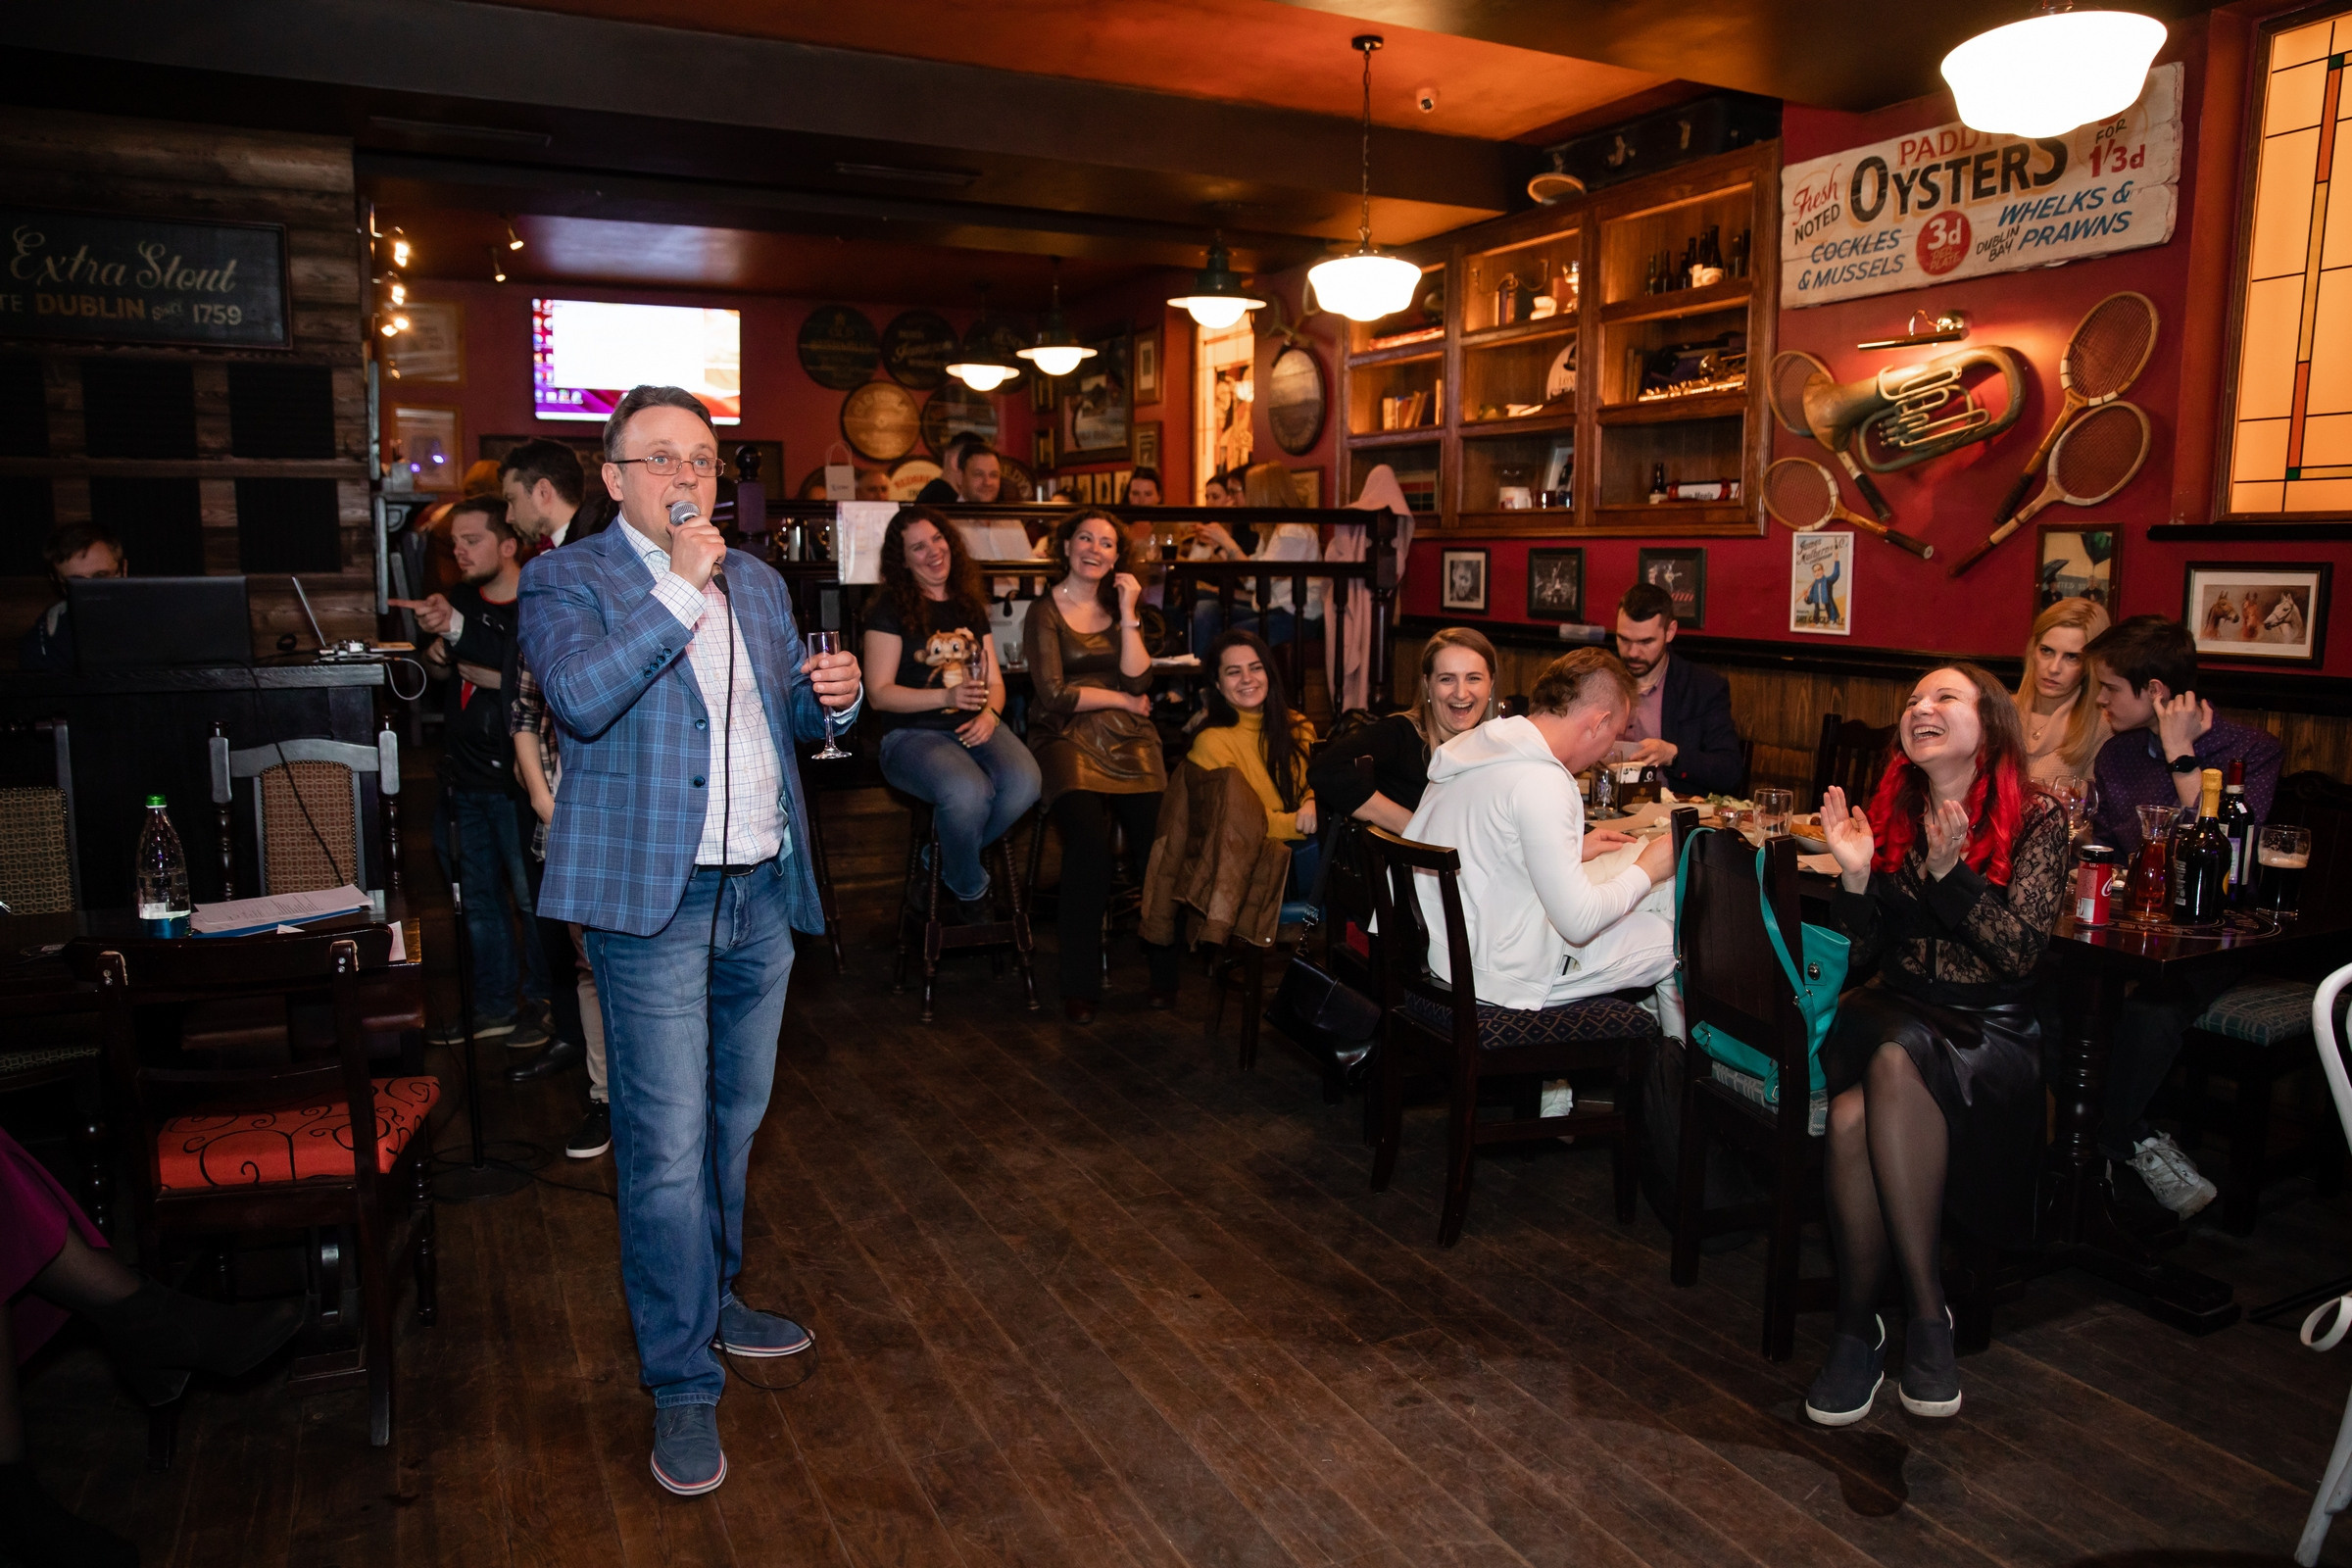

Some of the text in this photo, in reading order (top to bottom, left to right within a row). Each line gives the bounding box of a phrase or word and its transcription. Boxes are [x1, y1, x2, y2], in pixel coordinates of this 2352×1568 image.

[2095, 119, 2127, 144] FOR
[2089, 139, 2145, 178] 1/3d
[1792, 163, 1842, 225] Fresh
[1850, 137, 2068, 222] OYSTERS
[1997, 180, 2133, 227] WHELKS &
[1794, 203, 1840, 245] NOTED
[1927, 218, 1962, 251] 3d
[1976, 222, 2020, 255] DUBLIN
[2018, 211, 2132, 251] PRAWNS
[9, 224, 238, 293] Extra Stout
[1811, 228, 1902, 264] COCKLES
[1988, 239, 2014, 262] BAY
[35, 293, 146, 319] DUBLIN
[191, 303, 243, 325] 1759
